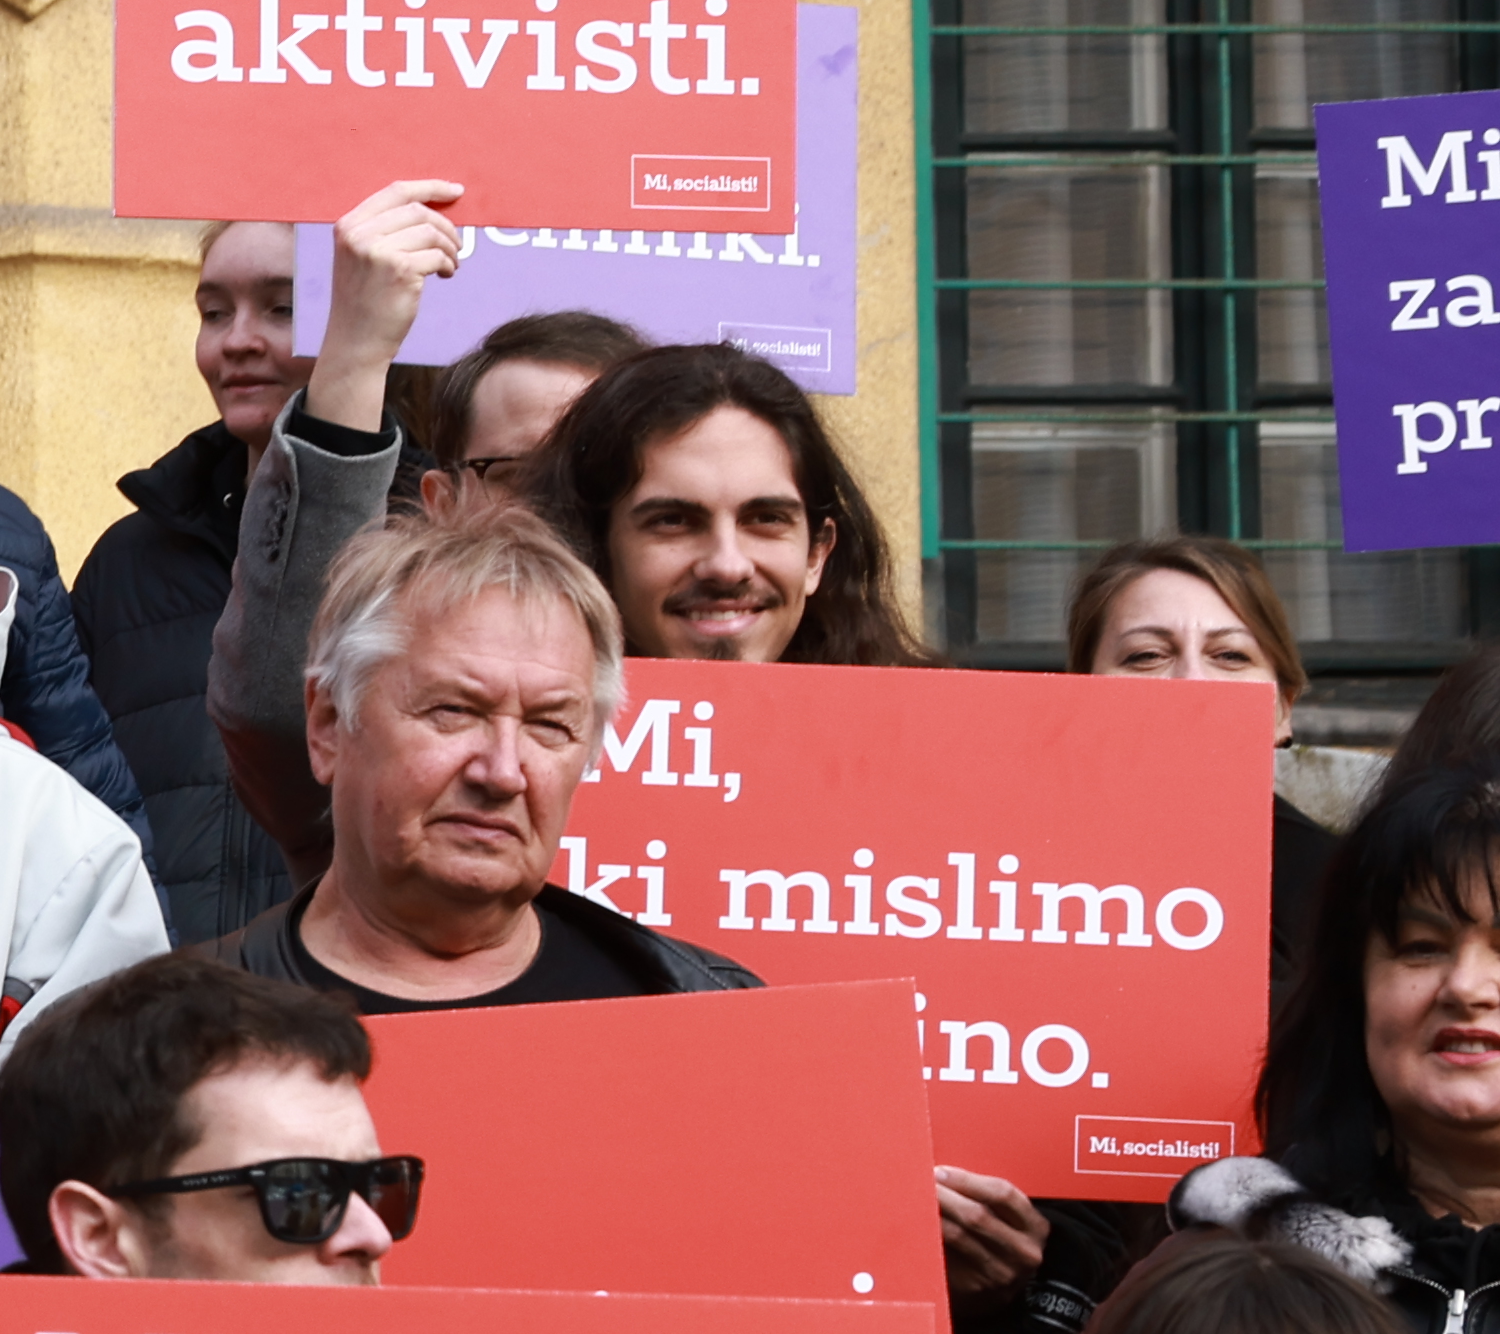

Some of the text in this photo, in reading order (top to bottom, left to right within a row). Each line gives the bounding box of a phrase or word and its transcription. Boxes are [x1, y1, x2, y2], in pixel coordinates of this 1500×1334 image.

[644, 174, 757, 192] Mi, socialisti!
[1389, 275, 1500, 330] za
[581, 699, 741, 803] Mi,
[560, 836, 1223, 950] ki mislimo
[1090, 1136, 1220, 1160] Mi, socialisti!
